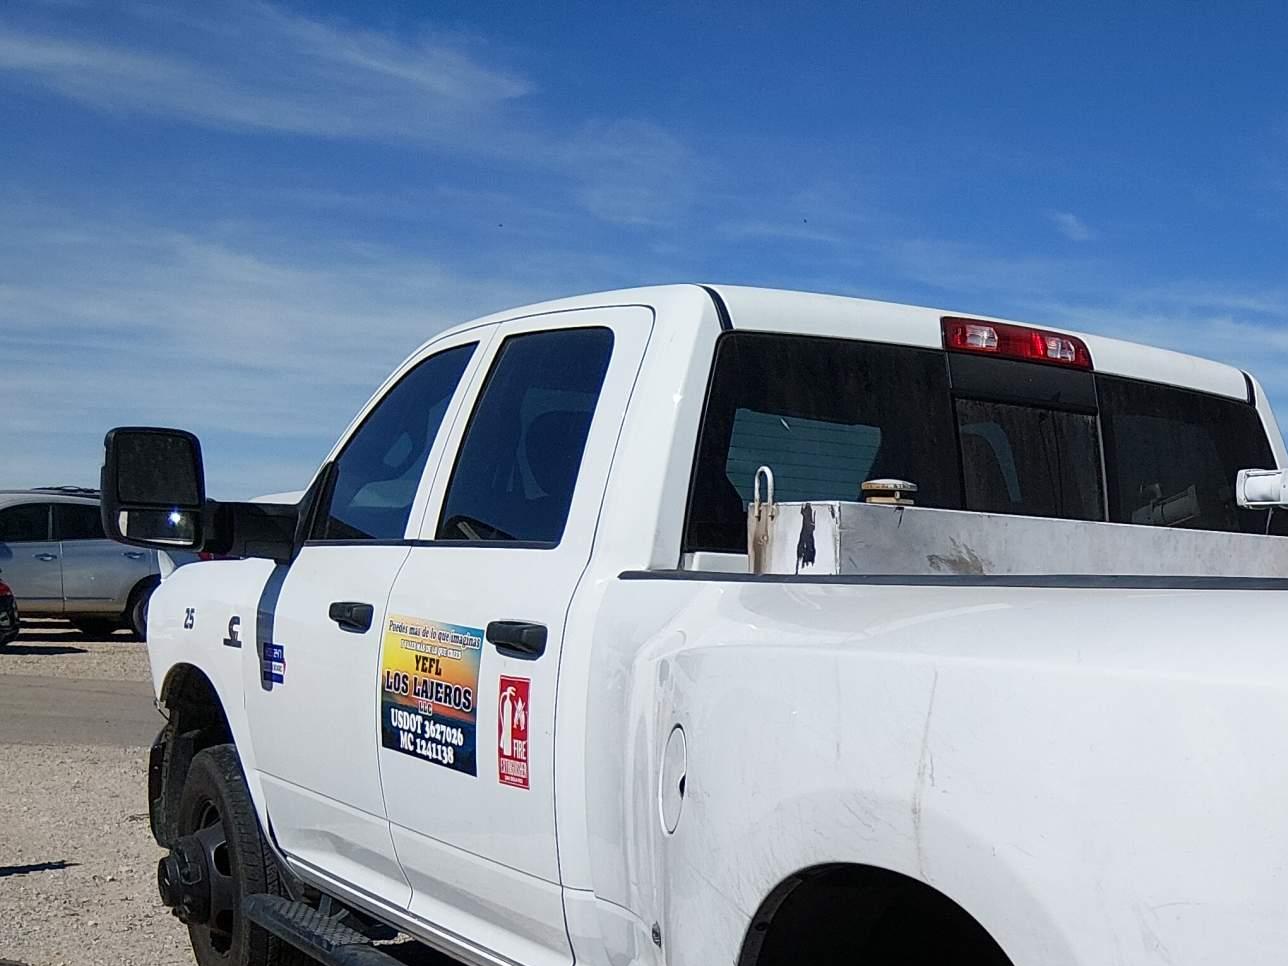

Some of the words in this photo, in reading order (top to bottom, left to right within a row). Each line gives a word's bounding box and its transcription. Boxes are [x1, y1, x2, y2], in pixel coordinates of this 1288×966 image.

[422, 626, 429, 639] de
[430, 627, 437, 640] lo
[438, 632, 449, 644] que
[415, 654, 442, 676] YEFL
[386, 670, 409, 695] LOS
[413, 676, 472, 711] LAJEROS
[418, 700, 433, 716] LLC
[390, 708, 423, 734] USDOT
[424, 720, 464, 746] 3627026
[400, 730, 414, 752] MC
[416, 738, 454, 764] 1241138
[513, 739, 528, 760] FIRE
